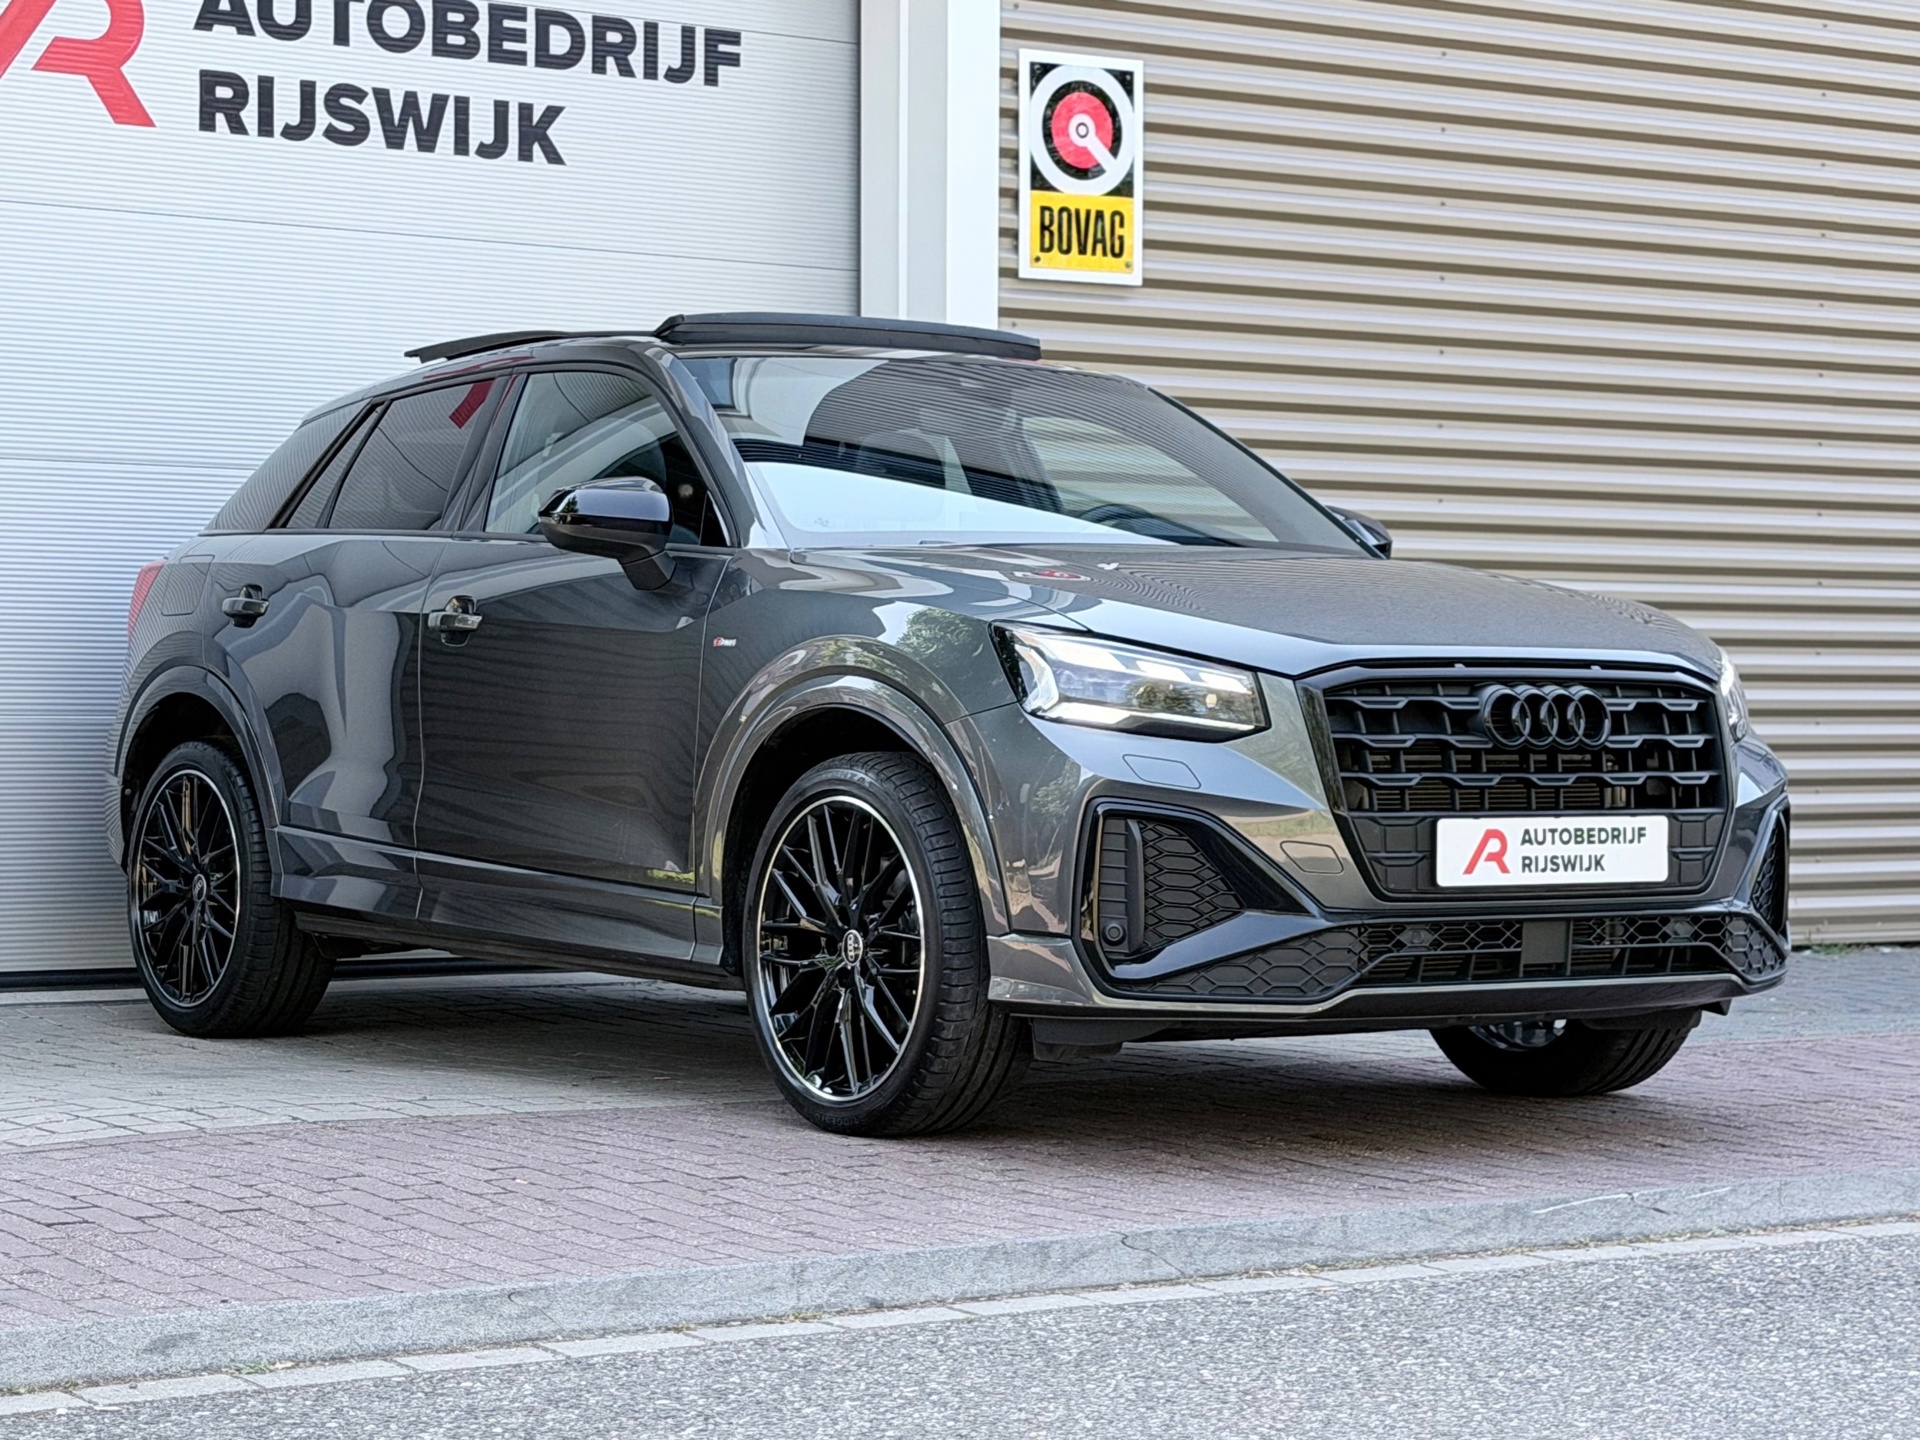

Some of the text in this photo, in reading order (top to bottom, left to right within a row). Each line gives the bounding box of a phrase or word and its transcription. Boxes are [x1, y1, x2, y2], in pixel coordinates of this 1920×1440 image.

[193, 0, 742, 87] AUTOBEDRIJF
[198, 69, 567, 166] RIJSWIJK
[1039, 205, 1125, 259] BOVAG
[1520, 826, 1647, 846] AUTOBEDRIJF
[1521, 854, 1606, 873] RIJSWIJK
